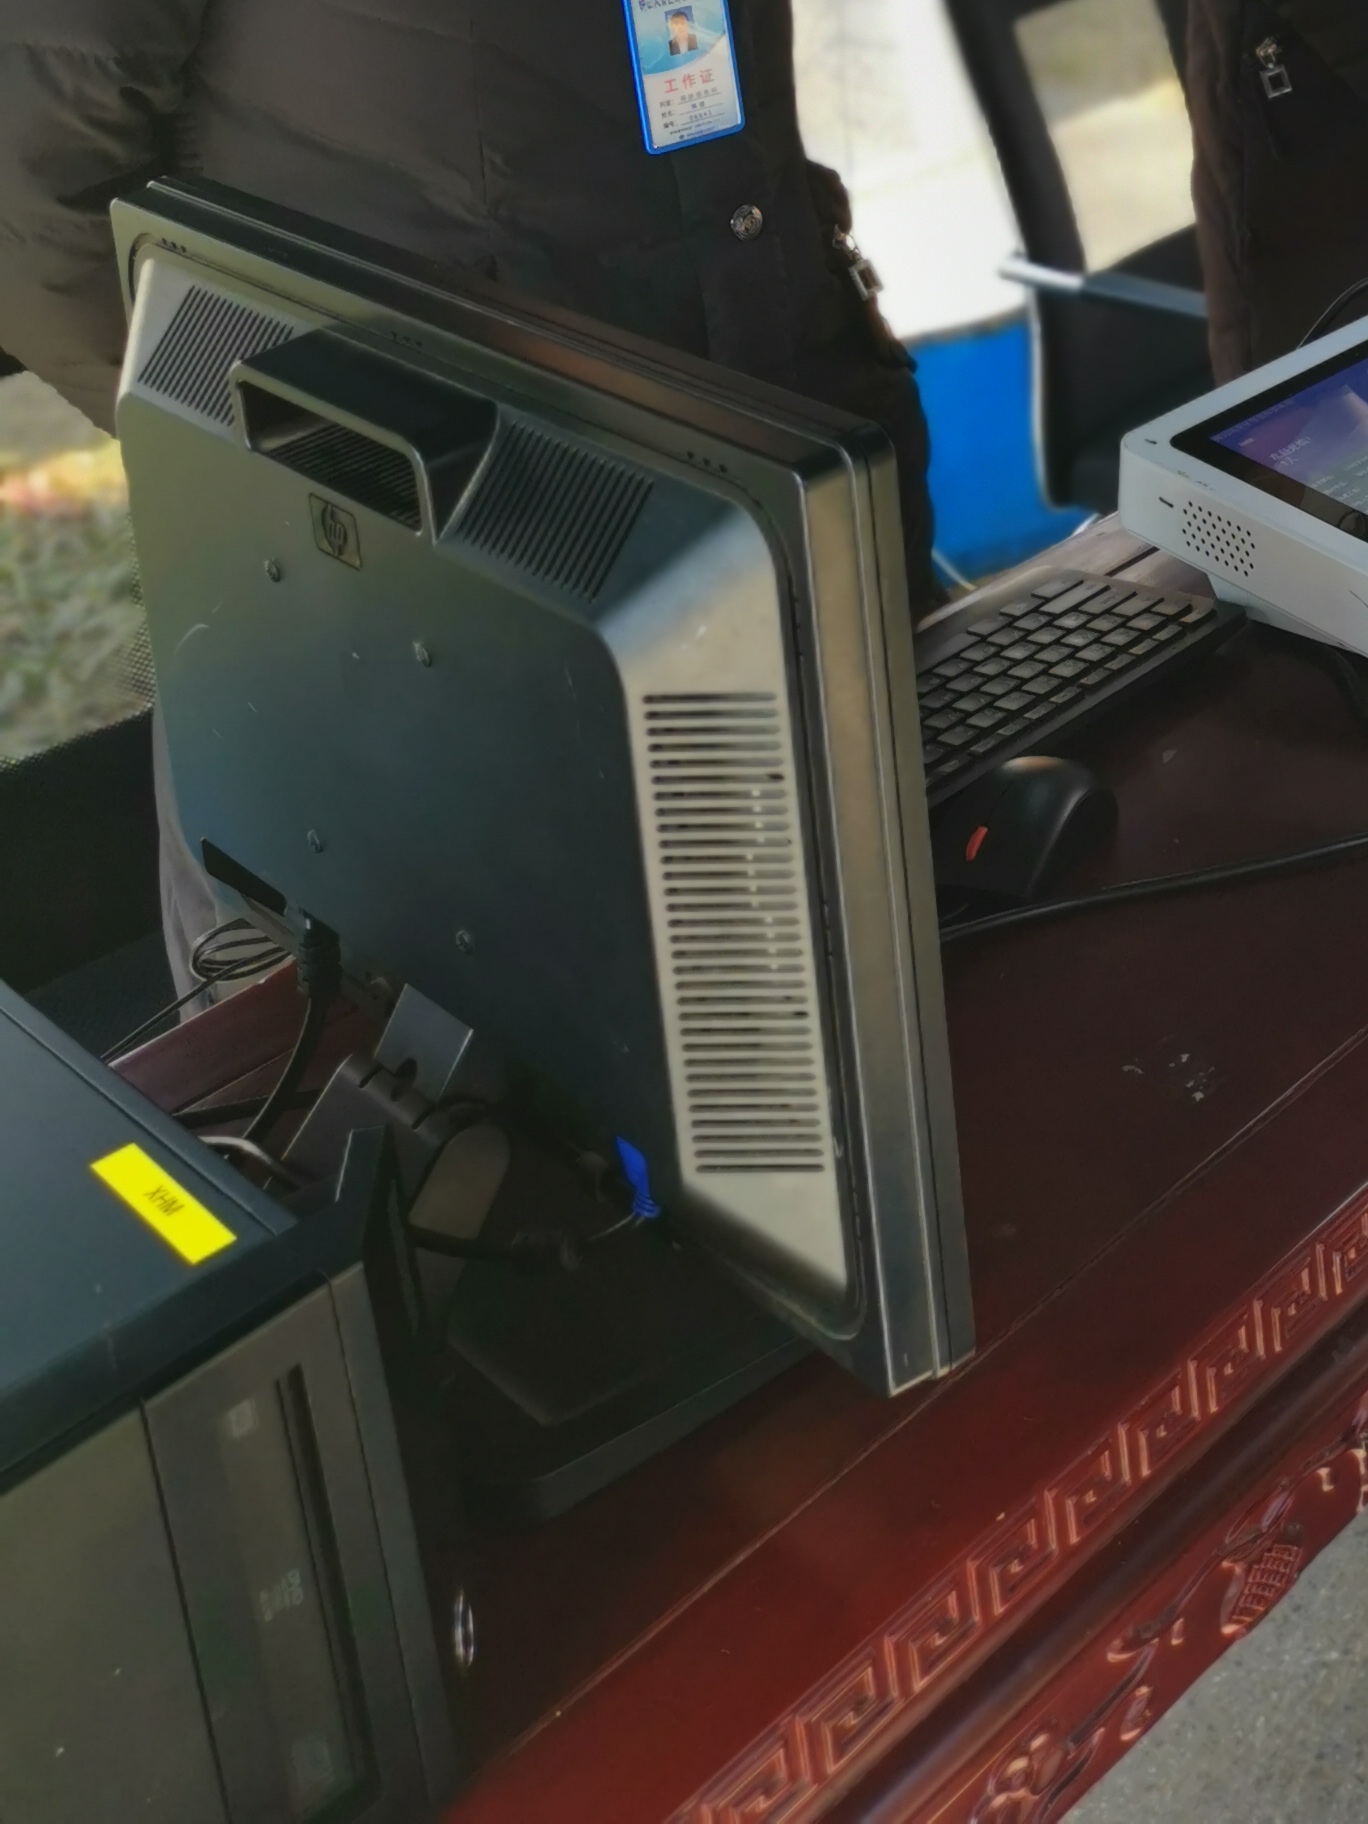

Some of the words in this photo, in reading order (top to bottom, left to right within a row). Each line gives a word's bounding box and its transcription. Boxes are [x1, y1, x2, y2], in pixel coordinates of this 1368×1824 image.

[664, 68, 715, 93] 工作证
[144, 1185, 185, 1216] XHM
